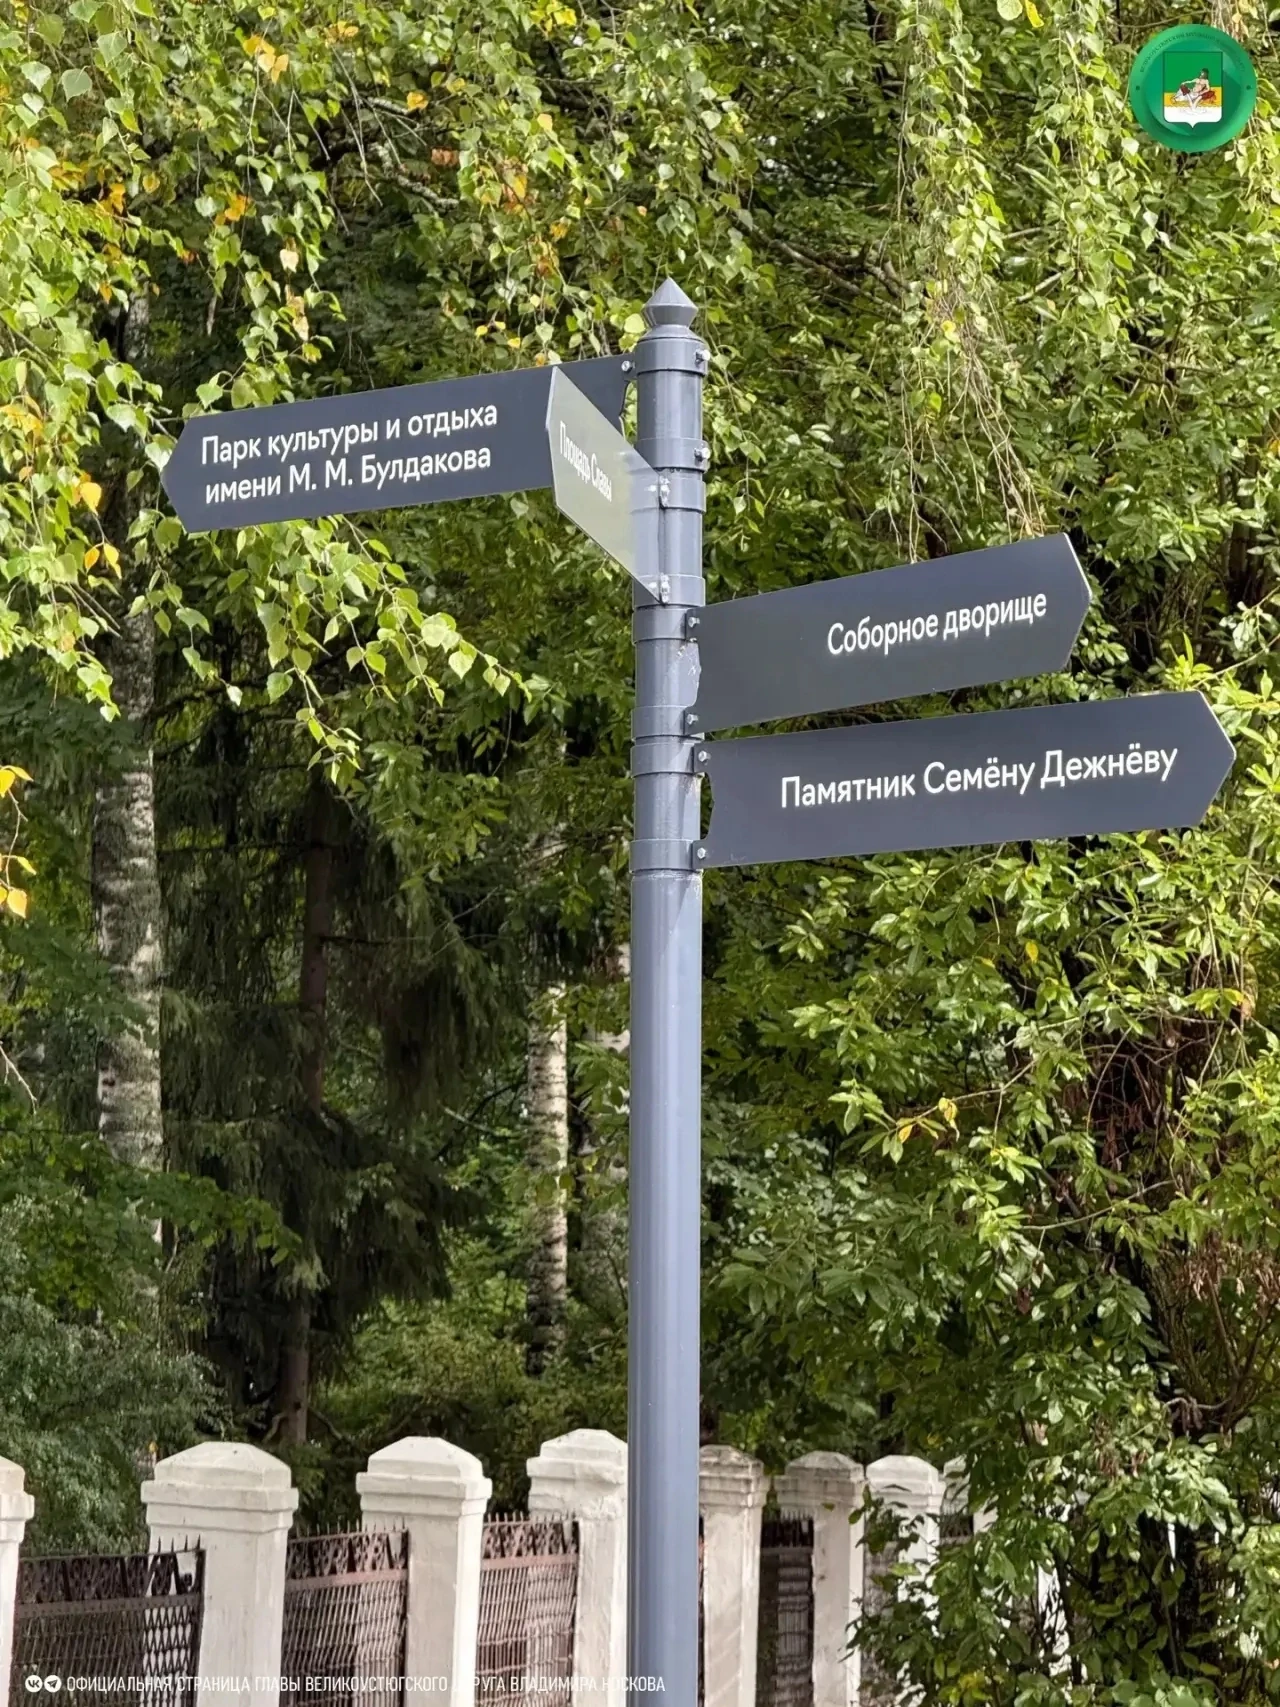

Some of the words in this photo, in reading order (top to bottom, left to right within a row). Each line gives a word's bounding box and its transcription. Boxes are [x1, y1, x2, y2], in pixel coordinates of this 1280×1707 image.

[201, 435, 262, 469] Парк
[267, 421, 379, 463] культуры
[385, 417, 401, 439] и
[407, 404, 498, 437] отдыха
[560, 420, 591, 484] Площадь
[591, 453, 612, 503] Славы
[205, 474, 282, 504] имени
[289, 463, 318, 493] М.
[325, 459, 353, 488] М.
[361, 447, 491, 490] Булдакова
[827, 614, 939, 656] Соборное
[943, 593, 1048, 639] дворище
[781, 771, 916, 808] Памятник
[923, 757, 1036, 795] Семёну
[1041, 742, 1178, 789] Дежнёву
